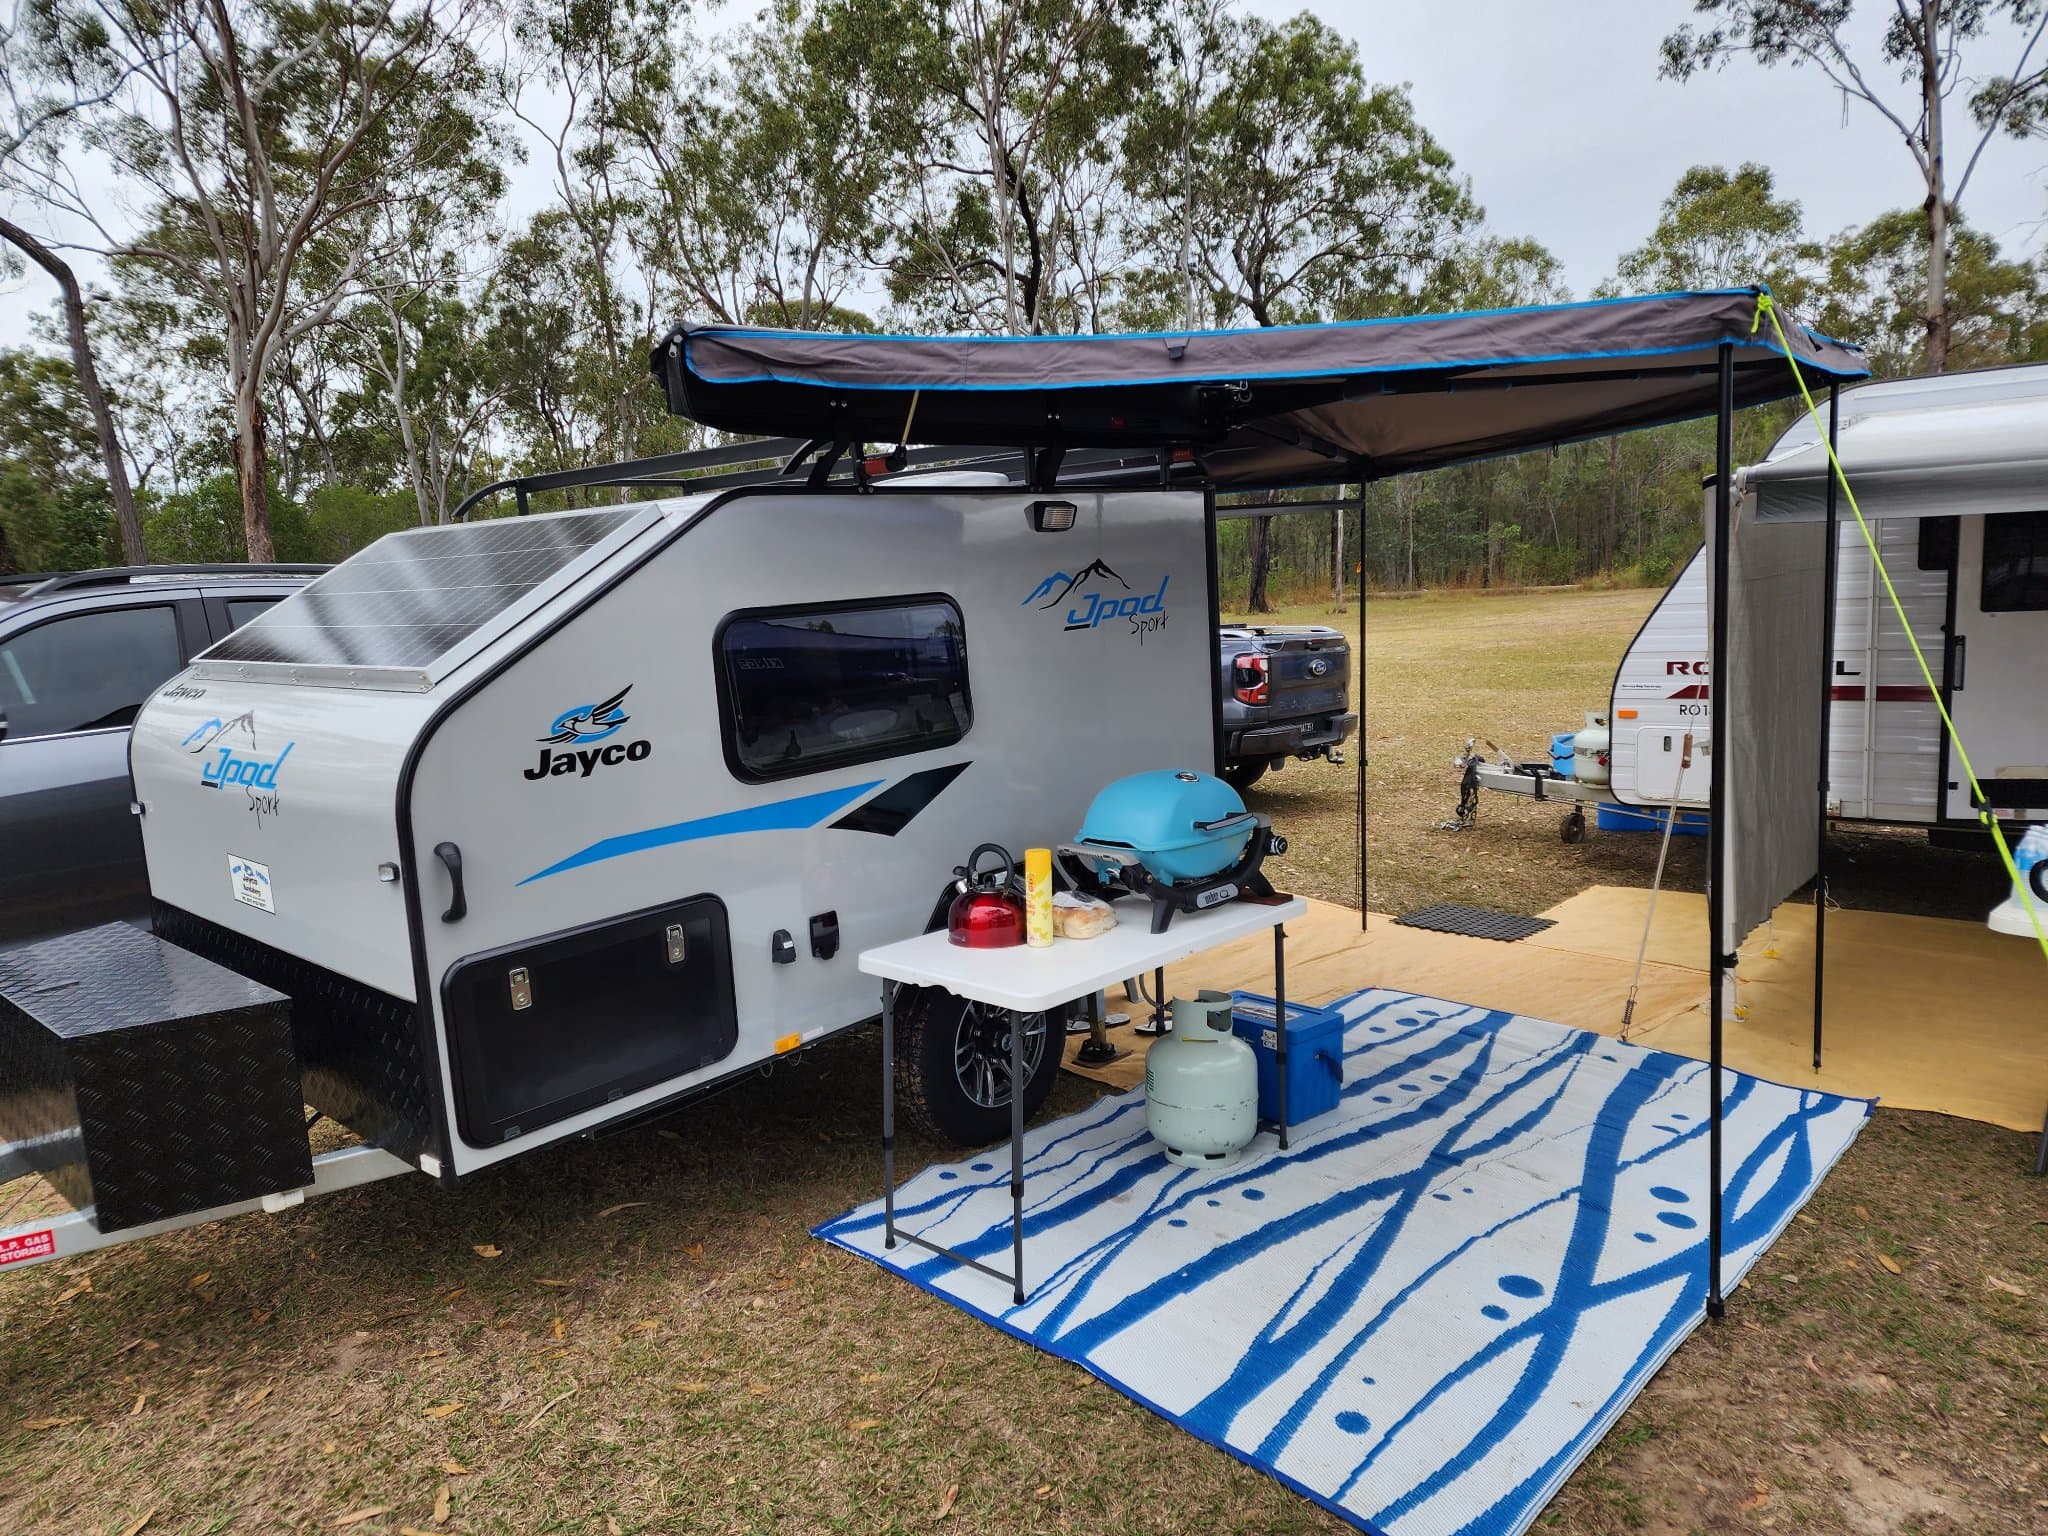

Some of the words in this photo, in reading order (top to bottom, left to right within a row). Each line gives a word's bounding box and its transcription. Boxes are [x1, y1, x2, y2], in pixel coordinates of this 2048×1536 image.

[1066, 575, 1170, 629] Jpod
[1129, 610, 1169, 647] Sport
[163, 683, 207, 702] Jayco
[1679, 704, 1711, 717] RO1
[202, 742, 295, 790] Jpod
[523, 740, 652, 781] Jayco
[246, 784, 281, 831] Sport
[0, 1243, 52, 1262] STORAGE
[24, 1233, 49, 1247] GAS
